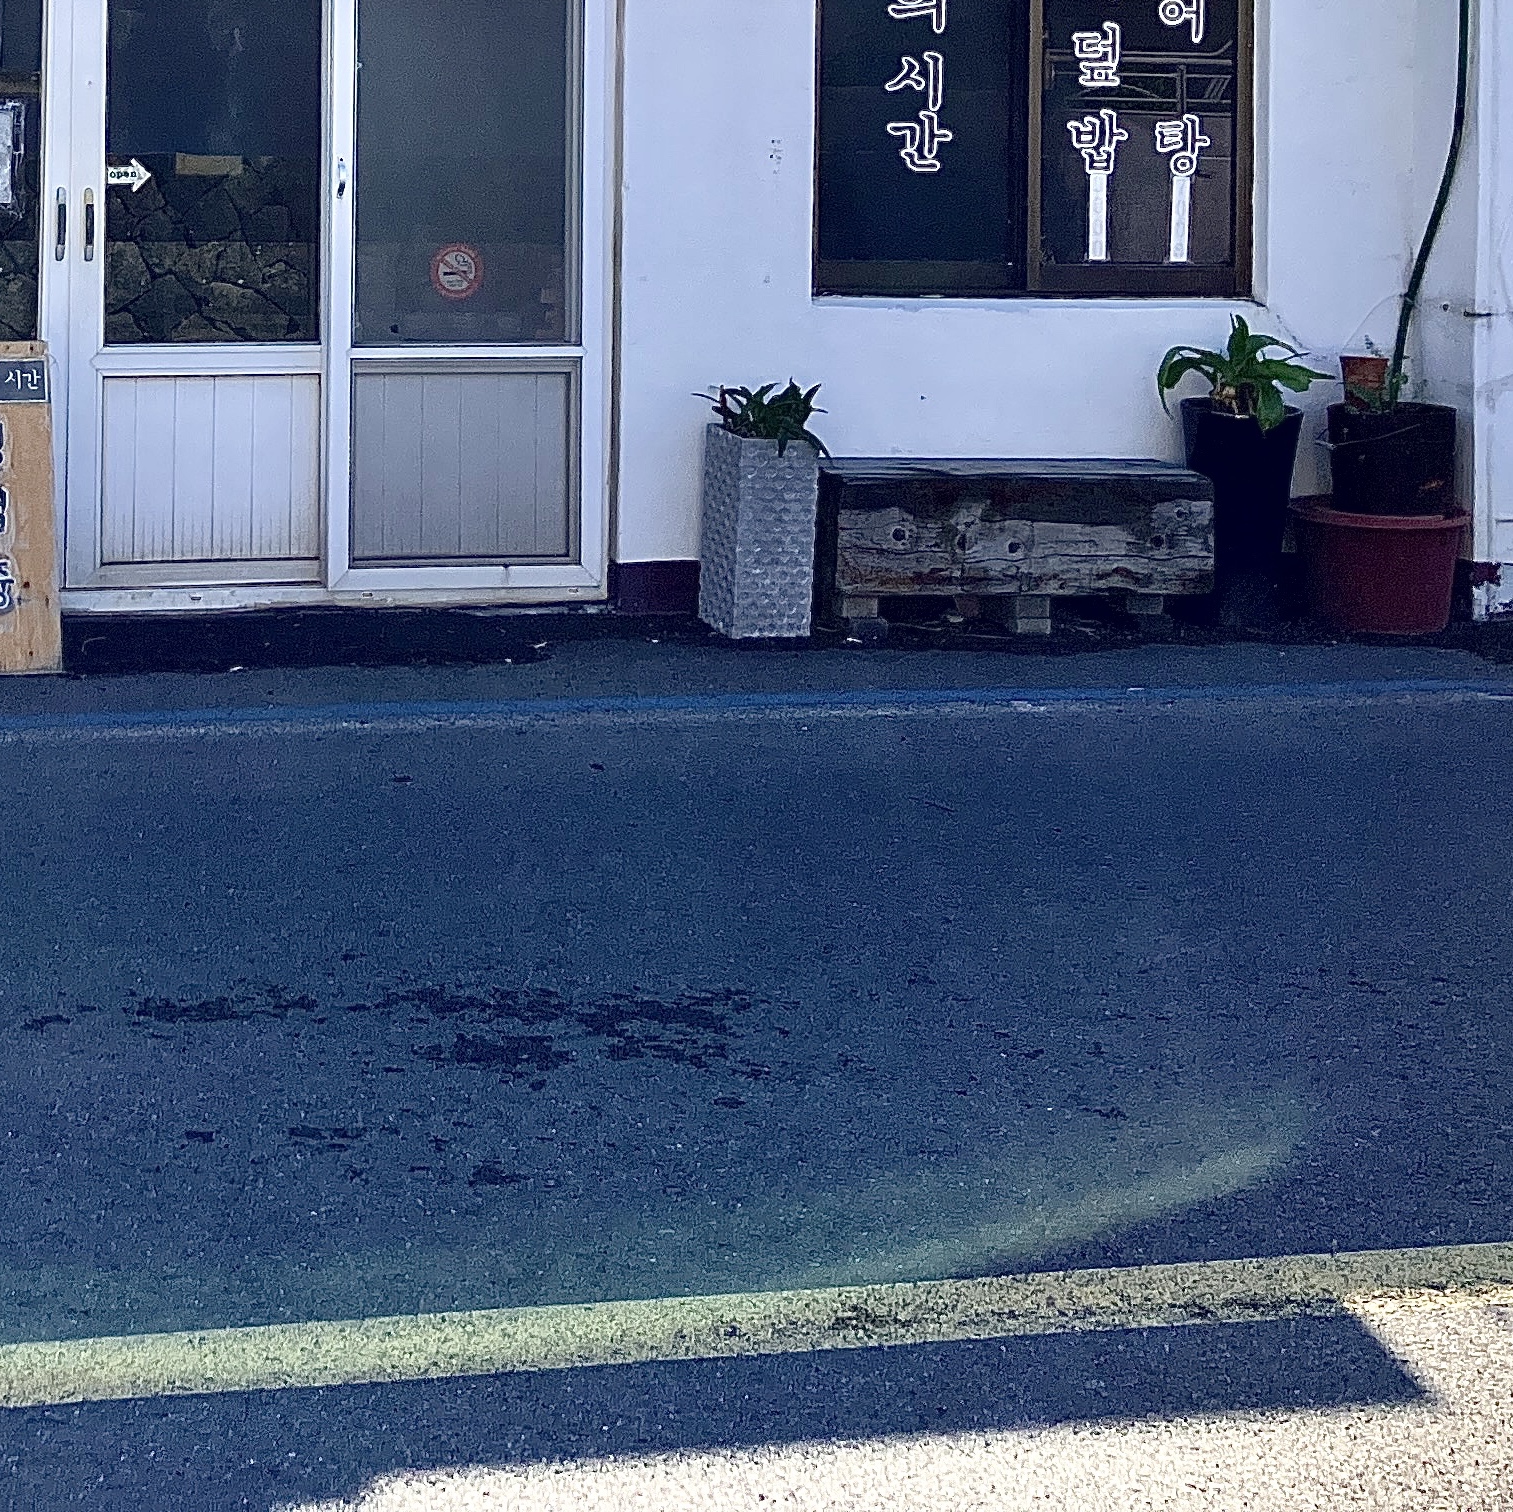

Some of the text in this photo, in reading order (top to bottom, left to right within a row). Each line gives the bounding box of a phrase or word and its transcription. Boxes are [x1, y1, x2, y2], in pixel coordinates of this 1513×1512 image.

[885, 51, 953, 172] 시간
[109, 170, 138, 180] open
[4, 368, 42, 391] 시간
